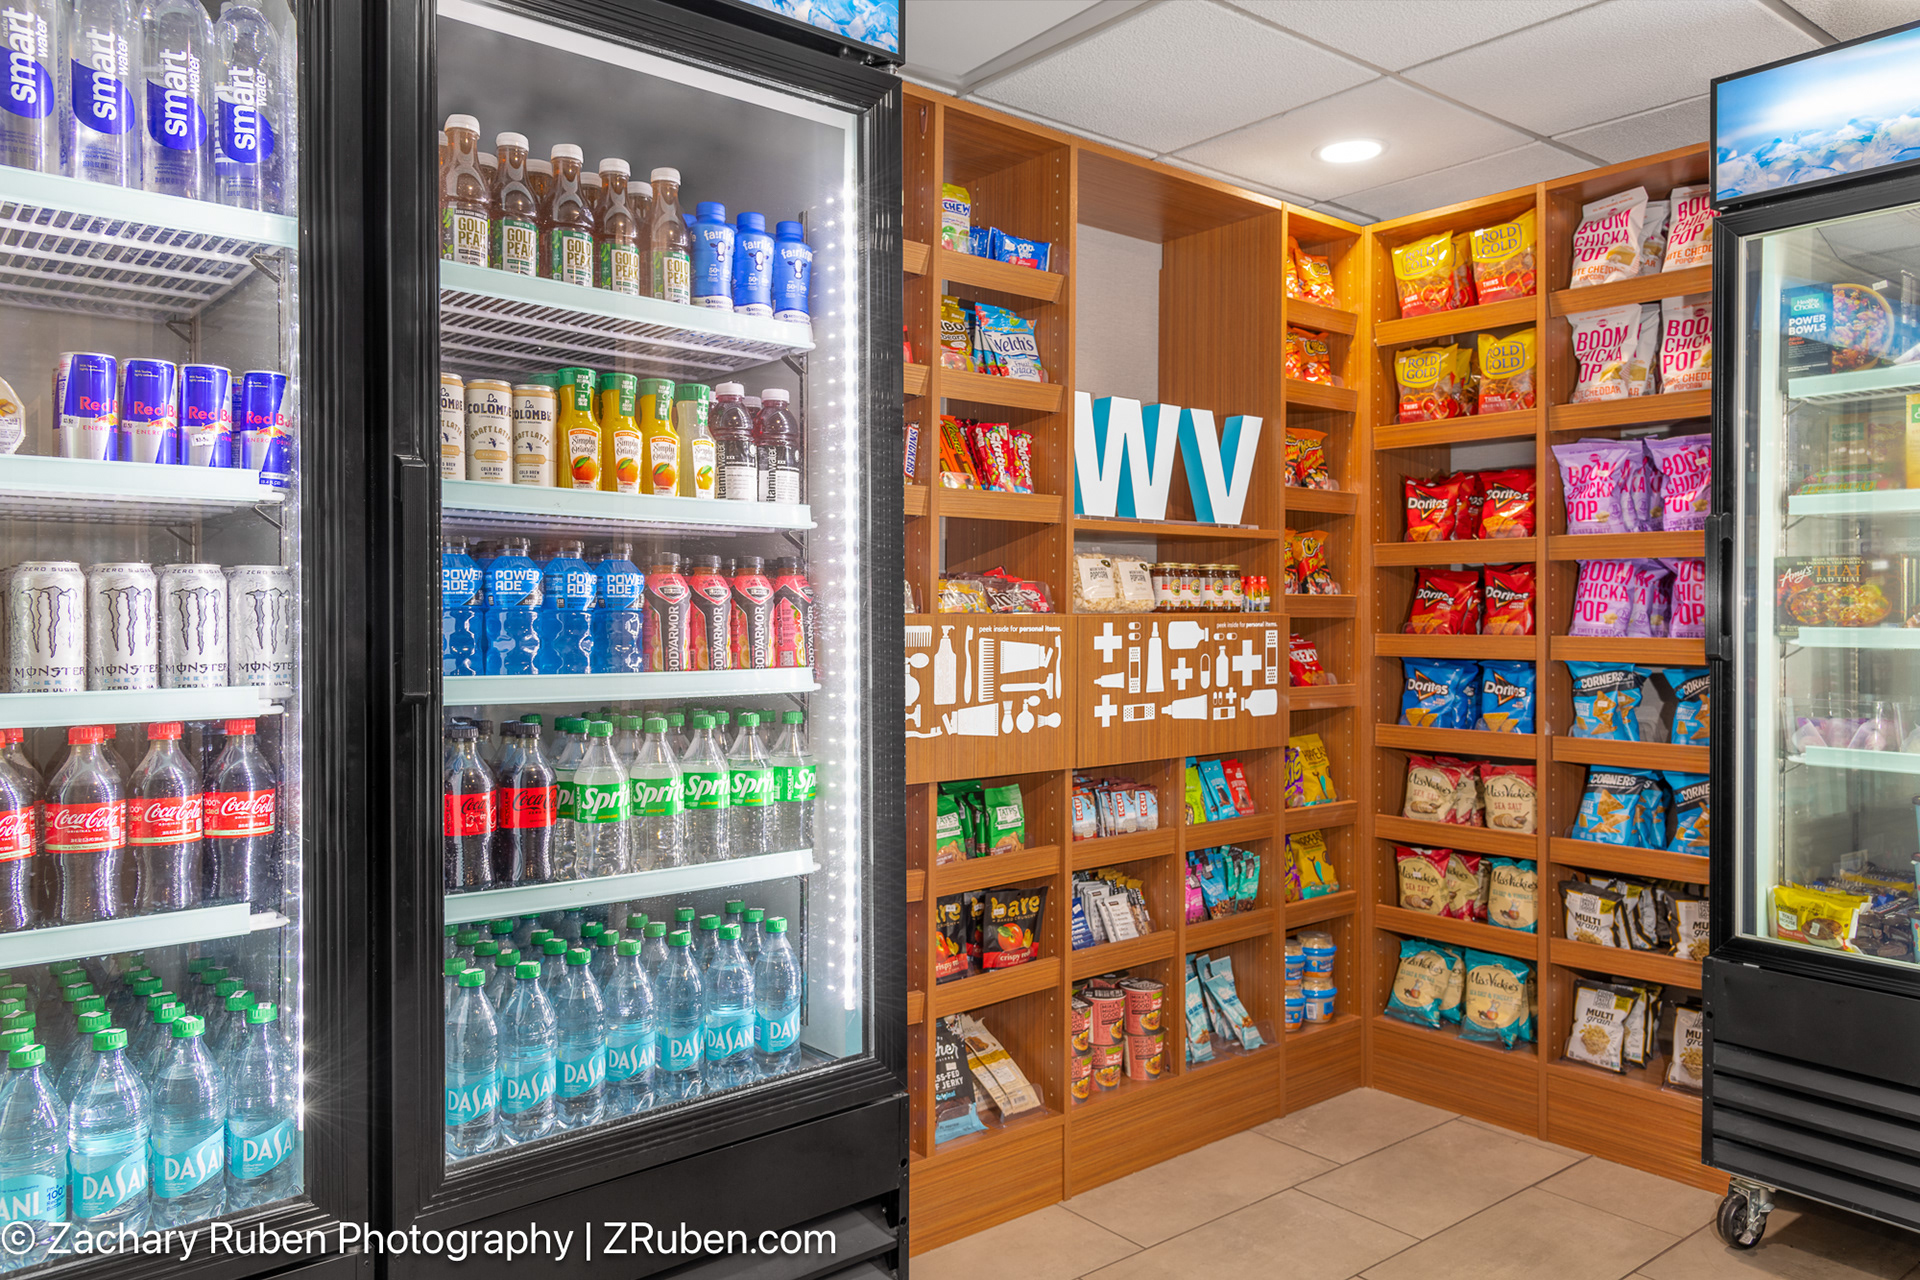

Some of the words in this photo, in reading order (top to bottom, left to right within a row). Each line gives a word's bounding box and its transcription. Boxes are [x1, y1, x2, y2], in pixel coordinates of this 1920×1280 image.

[33, 15, 48, 58] water
[2, 7, 37, 104] smart
[116, 35, 129, 76] water
[86, 29, 116, 121] smart
[160, 48, 188, 137] smart
[229, 65, 257, 150] smart
[1481, 226, 1517, 244] ROLD
[1574, 229, 1629, 248] CHICKA
[1667, 224, 1704, 250] POP
[1481, 238, 1518, 258] GOLD
[1789, 314, 1826, 326] POWER
[1788, 323, 1827, 336] BOWLS
[993, 336, 1034, 352] Welch's
[1576, 325, 1629, 352] BOOM
[1408, 356, 1438, 368] ROLD
[1662, 350, 1702, 374] POP
[1406, 367, 1437, 379] GOLD
[80, 396, 107, 411] Red
[487, 393, 498, 403] La
[525, 400, 534, 409] La
[133, 401, 164, 415] Red
[188, 406, 218, 420] Red
[246, 411, 273, 424] Red
[470, 426, 492, 440] DRAFT
[531, 430, 550, 446] LATTE
[905, 429, 919, 478] SNICKERS
[1074, 389, 1264, 525] WV
[1407, 497, 1449, 509] Doritos
[1567, 500, 1598, 523] POP
[495, 569, 540, 581] POWER
[1580, 561, 1634, 586] BOOM
[1780, 566, 1813, 588] Amy's
[1813, 565, 1862, 577] THAI
[495, 580, 522, 591] ADE
[607, 584, 632, 594] ADE
[1578, 584, 1629, 602] CHICKA
[1573, 601, 1608, 623] POP
[979, 625, 992, 634] peek
[993, 625, 1010, 633] inside
[1010, 625, 1018, 633] for
[1019, 625, 1044, 634] personal
[1216, 622, 1227, 630] peek
[1246, 621, 1264, 629] personal
[1407, 678, 1449, 696] Doritos
[1581, 672, 1625, 689] CORNERS
[1484, 681, 1527, 698] Doritos
[1590, 774, 1637, 786] CORNERS
[144, 798, 202, 824] Coca-Cola
[221, 794, 275, 817] Coca-Cola
[1494, 802, 1505, 810] SEA
[1506, 802, 1522, 811] SALT
[53, 805, 120, 831] Coca-Cola
[1405, 882, 1417, 891] SEA
[990, 895, 1040, 919] bare
[1575, 912, 1600, 926] MULTI
[1779, 917, 1796, 927] HOUSE
[1782, 912, 1794, 921] TOLL
[1577, 919, 1600, 931] grain
[1000, 953, 1020, 963] crispy
[1586, 1007, 1614, 1021] MULTI
[1586, 1015, 1611, 1026] grain
[942, 1077, 964, 1090] JERKY
